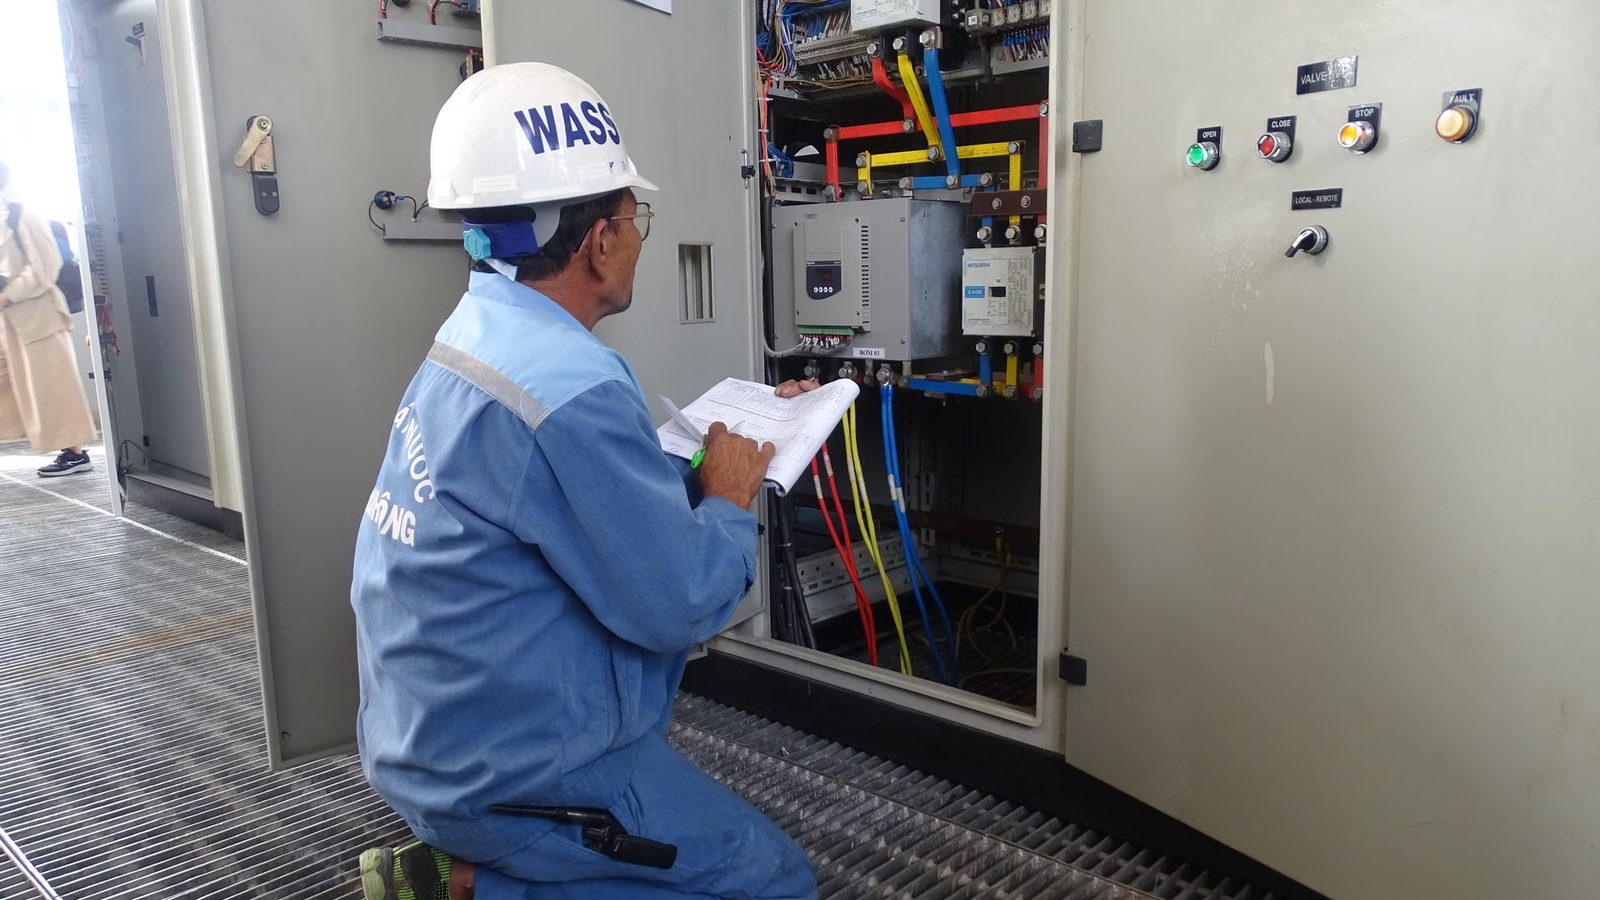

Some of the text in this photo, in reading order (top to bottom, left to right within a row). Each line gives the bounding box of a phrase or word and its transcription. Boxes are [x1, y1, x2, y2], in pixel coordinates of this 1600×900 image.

[1301, 71, 1327, 84] VALVE
[1449, 93, 1475, 104] FAULT
[1355, 108, 1374, 118] STOP
[514, 100, 620, 154] WASS
[1271, 119, 1291, 128] CLOSE
[1202, 130, 1217, 138] OPEN
[1295, 196, 1312, 204] LOCAL
[1316, 194, 1338, 202] REMOTE
